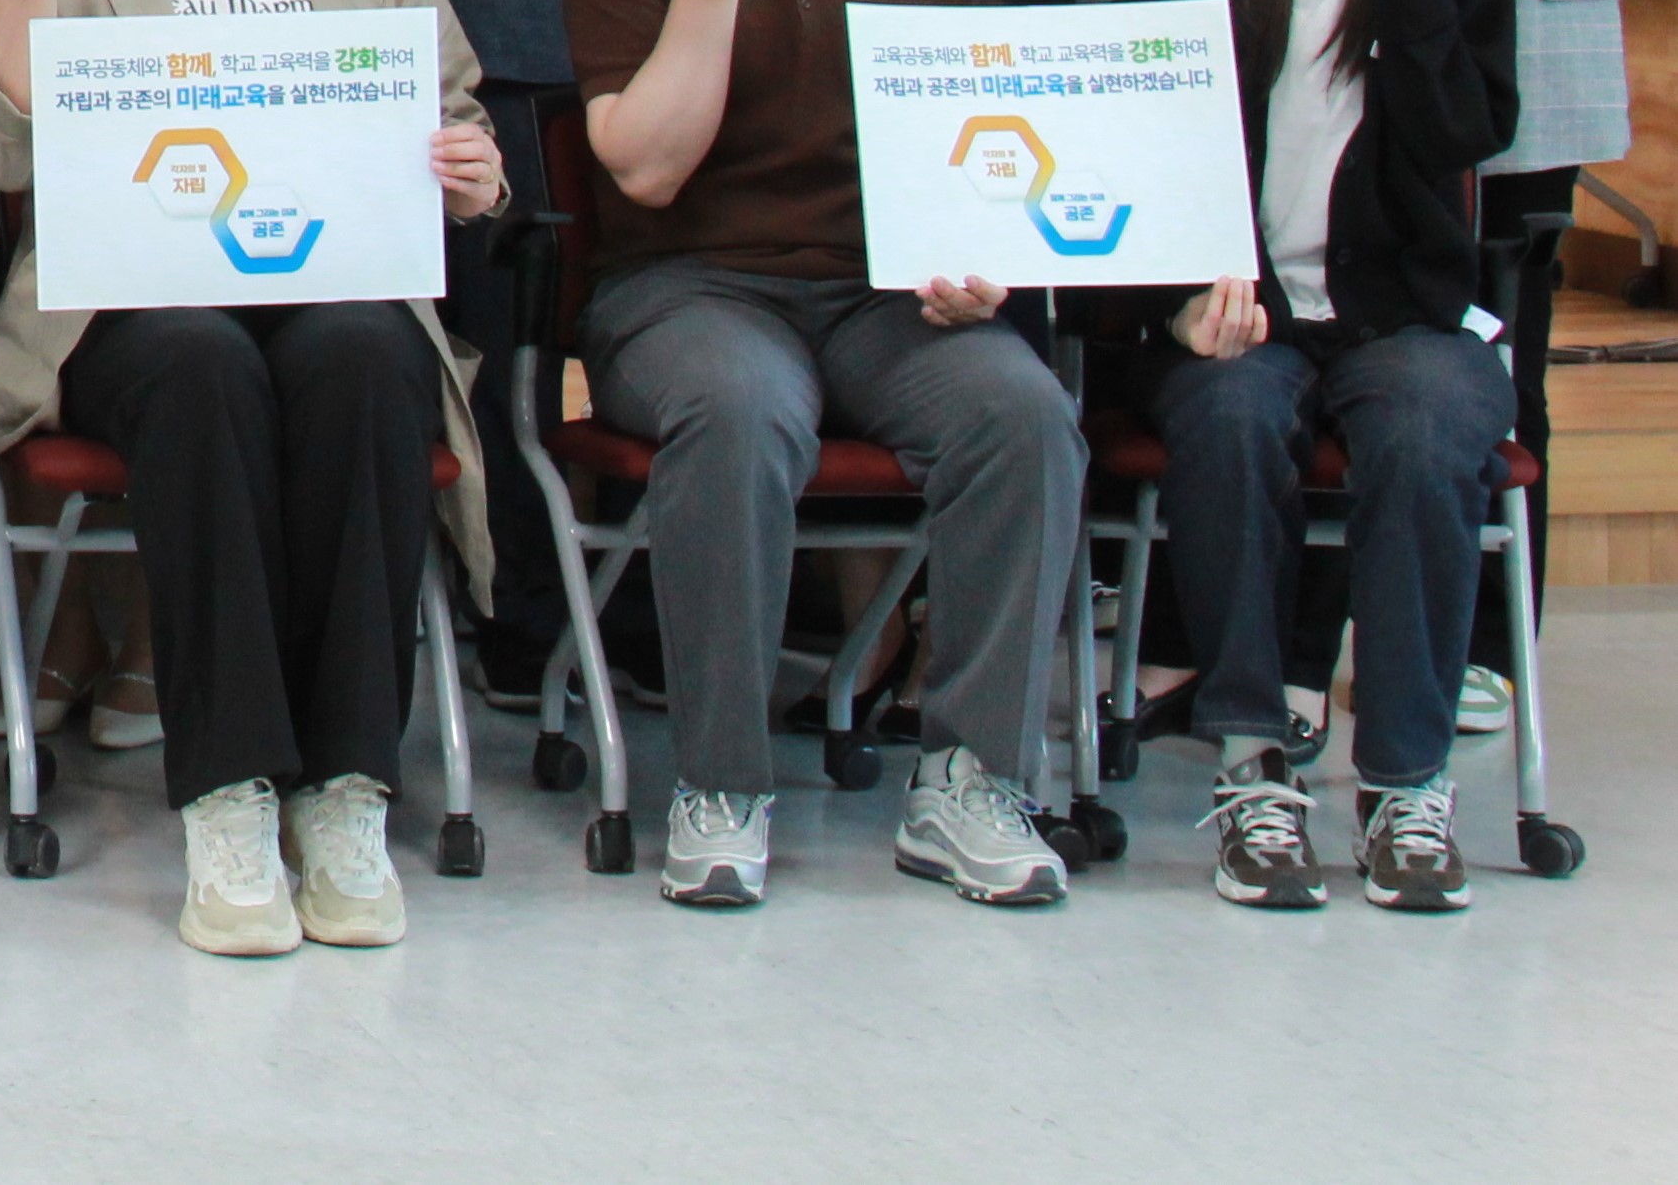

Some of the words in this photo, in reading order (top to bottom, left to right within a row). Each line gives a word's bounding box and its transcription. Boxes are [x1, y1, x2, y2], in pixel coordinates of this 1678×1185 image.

[55, 55, 164, 80] 교육공동체와
[166, 52, 218, 79] 함께,
[220, 53, 257, 74] 학교
[260, 50, 331, 73] 교육력을
[334, 46, 415, 74] 강화하여
[871, 46, 967, 66] 교육공동체와
[968, 43, 1017, 68] 함께,
[1019, 43, 1054, 63] 학교
[1057, 41, 1125, 63] 교육력을
[1127, 37, 1208, 64] 강화하여
[873, 77, 923, 97] 자립과
[926, 76, 977, 97] 공존의
[981, 72, 1084, 98] 미래교육을
[1086, 68, 1214, 94] 실현하겠습니다
[55, 90, 112, 112] 자립과
[116, 87, 171, 111] 공존의
[176, 83, 285, 112] 미래교육을
[290, 79, 417, 105] 실현하겠습니다
[986, 162, 1017, 178] 자립
[172, 177, 205, 194] 자립
[1064, 205, 1095, 221] 공존
[252, 221, 284, 238] 공존
